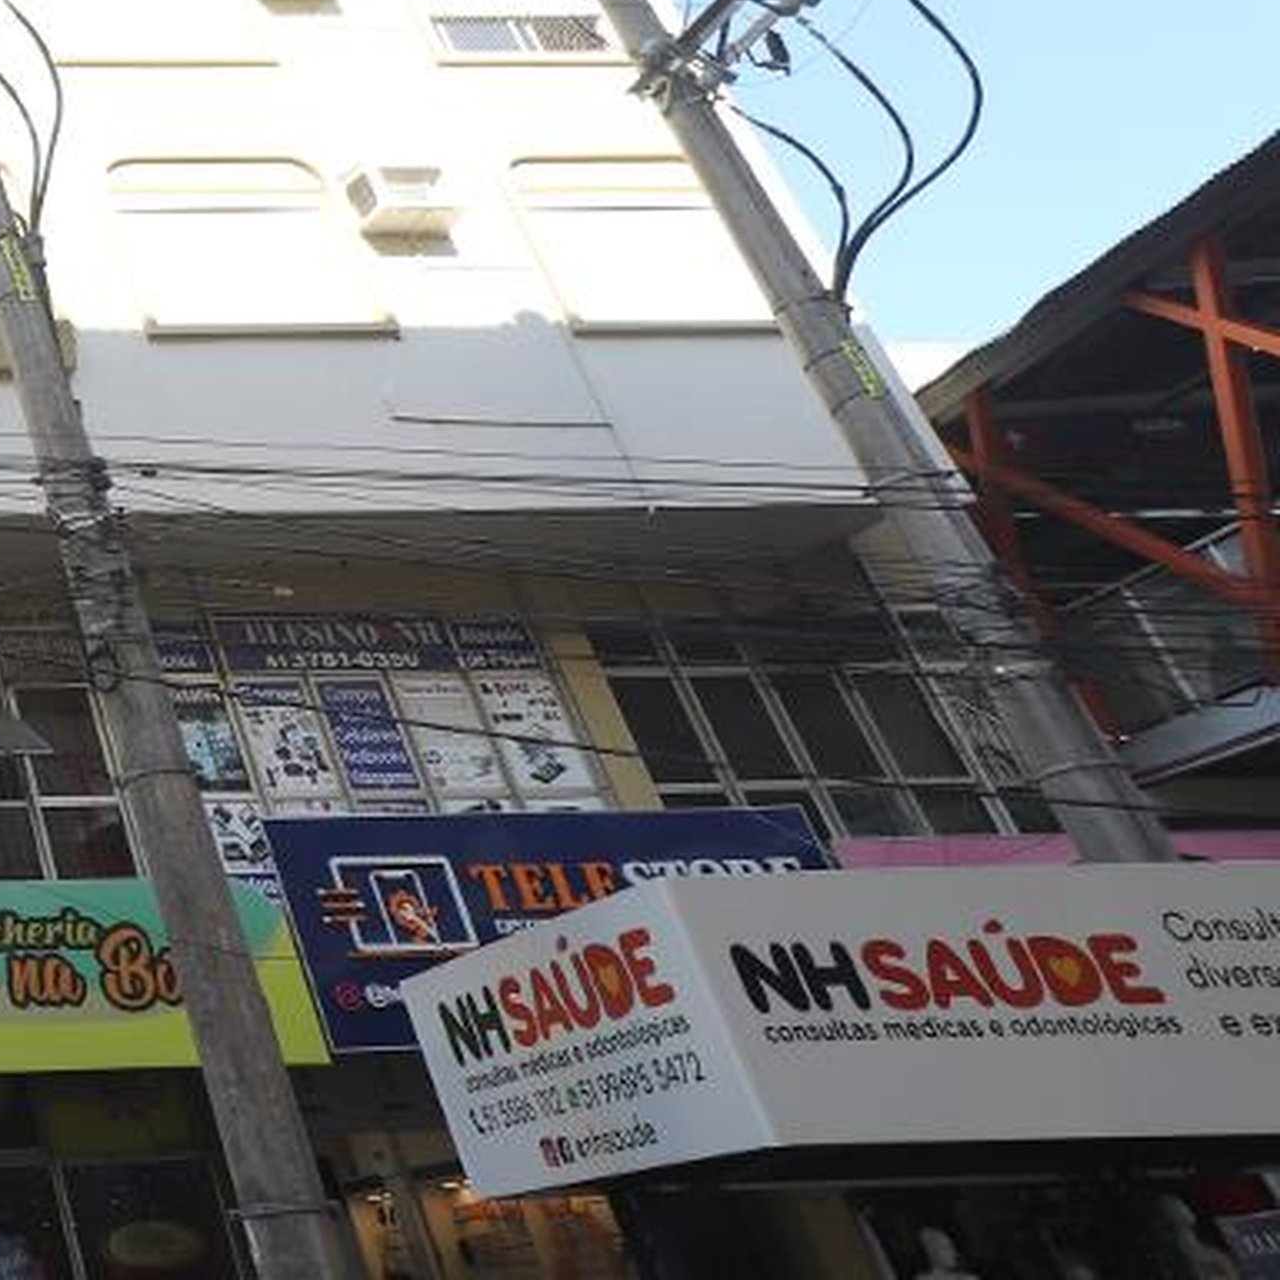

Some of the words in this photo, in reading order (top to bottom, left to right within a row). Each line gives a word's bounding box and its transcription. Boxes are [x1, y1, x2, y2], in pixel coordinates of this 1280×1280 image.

[9, 954, 86, 1008] na
[765, 1019, 878, 1044] consultas
[883, 1015, 985, 1040] médicas
[990, 1021, 1004, 1037] e
[1012, 1011, 1183, 1039] odontológicas
[1219, 1014, 1242, 1037] e
